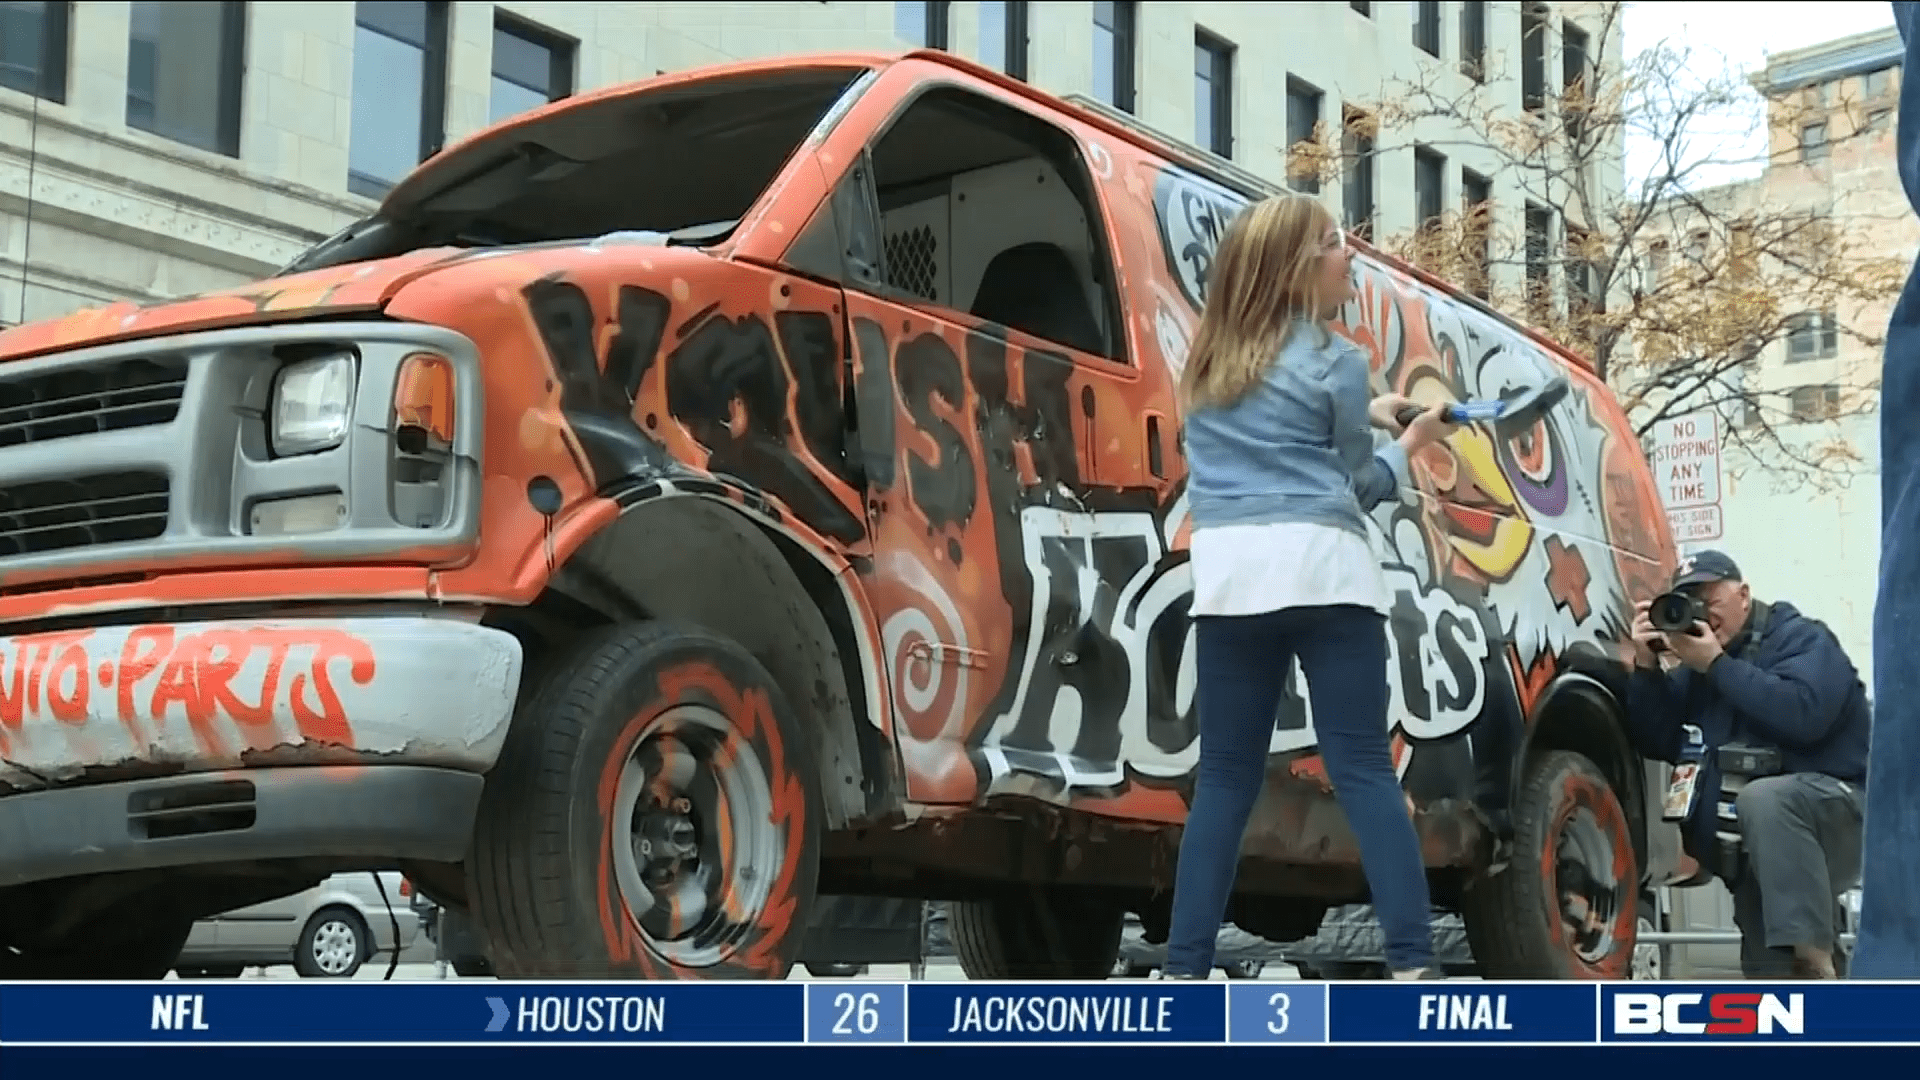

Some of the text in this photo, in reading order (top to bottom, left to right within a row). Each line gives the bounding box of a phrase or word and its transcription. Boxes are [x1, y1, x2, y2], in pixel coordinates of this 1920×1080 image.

[1673, 421, 1696, 438] NO
[1656, 440, 1715, 462] STOPPING
[1671, 463, 1702, 481] ANY
[1670, 482, 1705, 501] TIME
